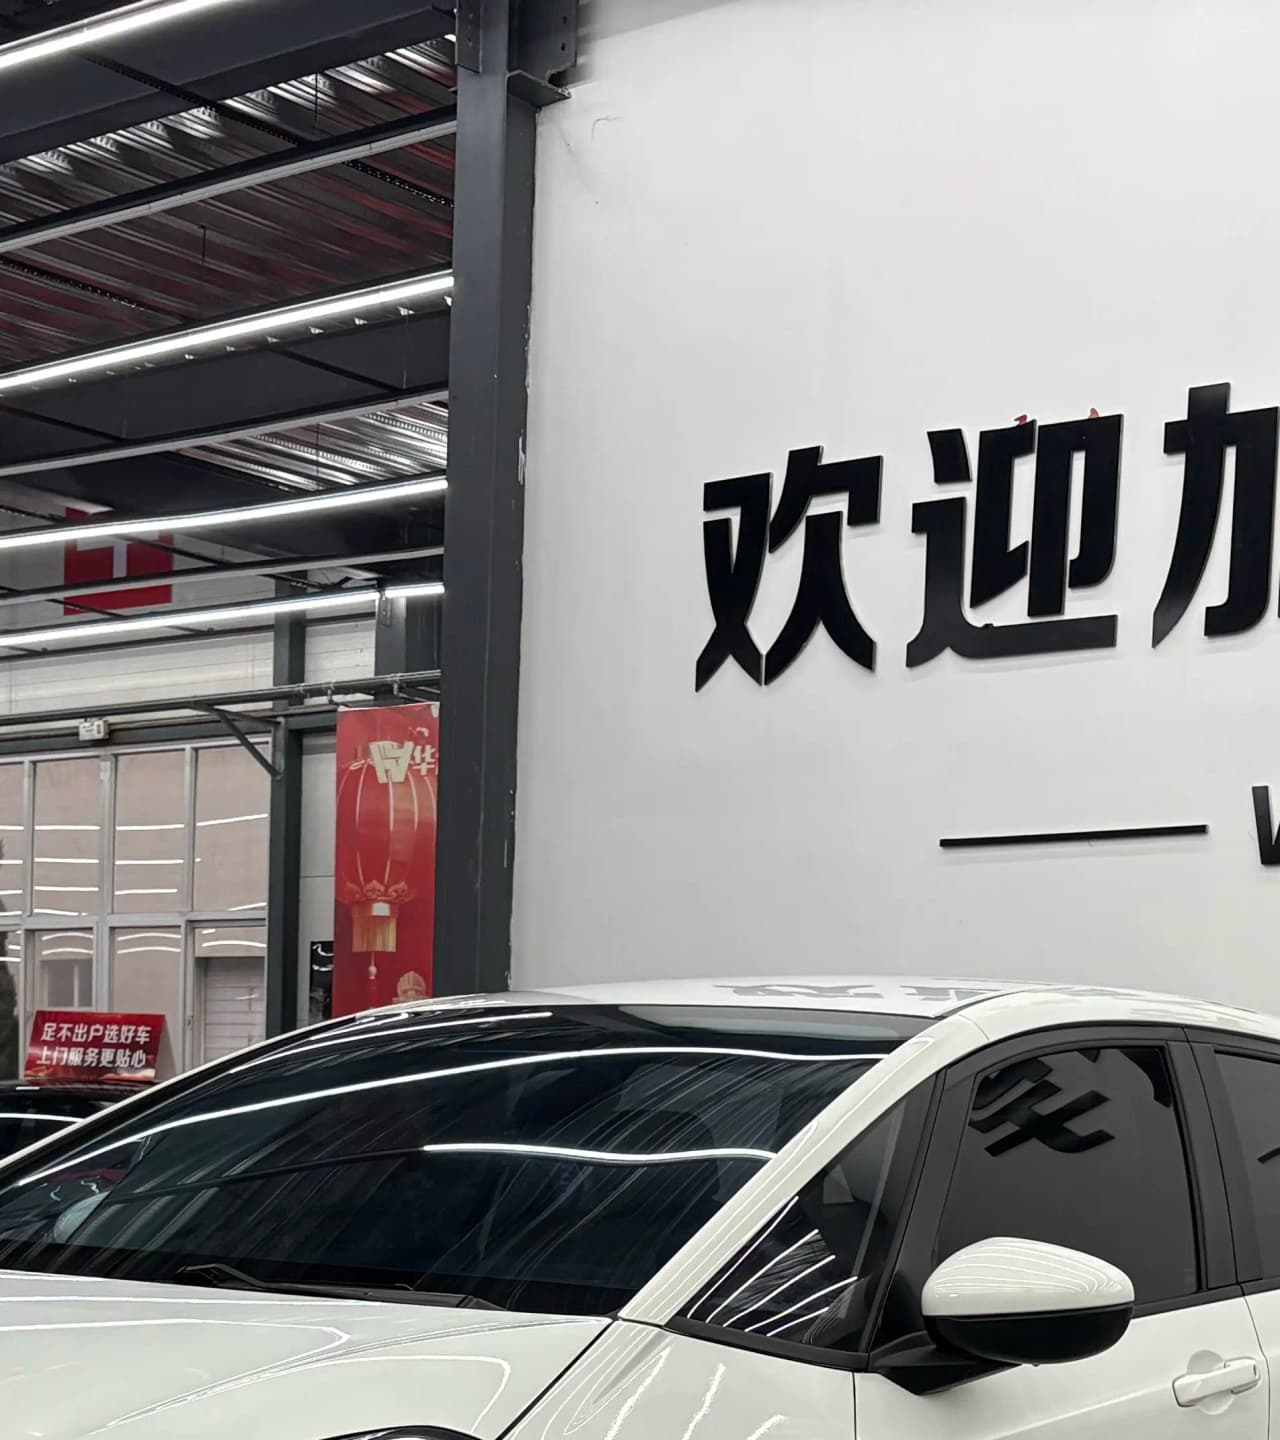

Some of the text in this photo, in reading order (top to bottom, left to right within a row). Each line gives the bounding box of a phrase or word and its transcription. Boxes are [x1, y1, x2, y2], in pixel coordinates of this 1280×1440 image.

[40, 1023, 152, 1045] 足不出户选好车
[36, 1048, 146, 1069] 上门服务更贴心
